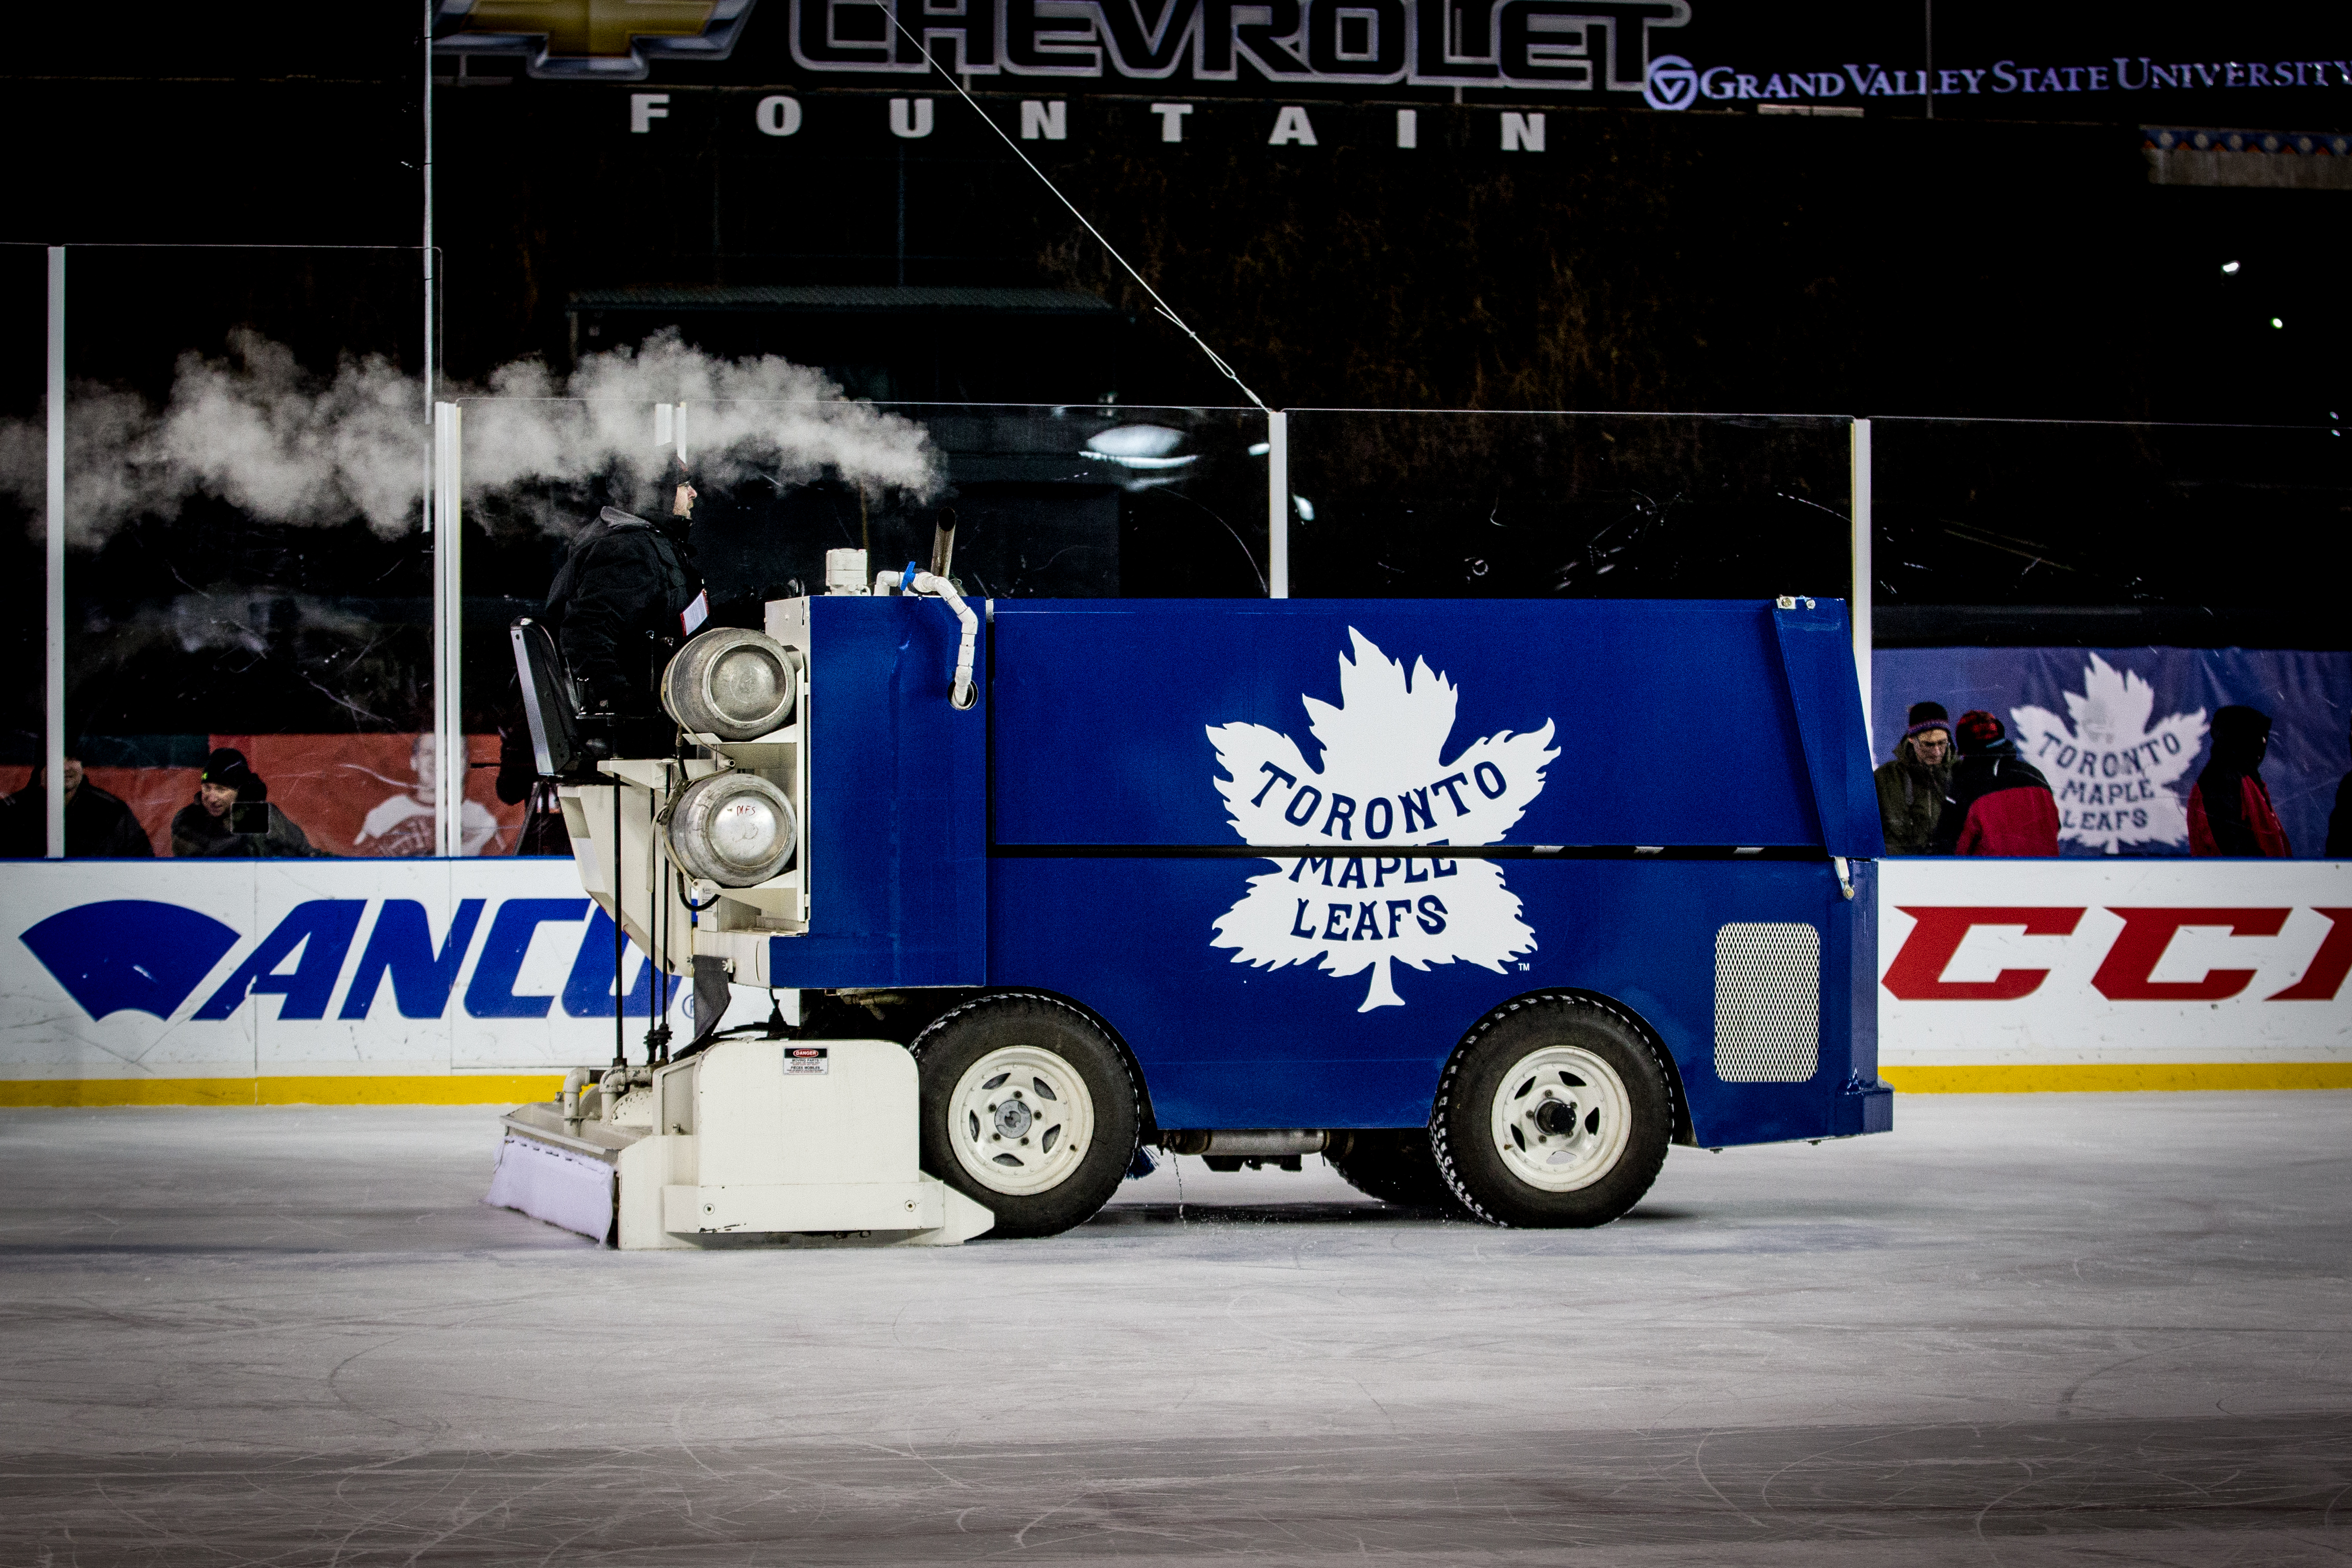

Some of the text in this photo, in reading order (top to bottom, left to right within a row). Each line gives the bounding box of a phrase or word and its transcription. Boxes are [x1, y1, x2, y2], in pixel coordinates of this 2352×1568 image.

[789, 0, 1692, 92] CHEVROLET
[1699, 57, 2352, 100] GRAND VALLEY STATE UNIVERSITY
[2038, 731, 2181, 778] TORONTO
[1250, 760, 1507, 841] TORONTO
[2060, 779, 2155, 805] MAPLE
[2062, 806, 2149, 831] LEAFS
[1288, 838, 1458, 890] MAPLE
[1290, 895, 1448, 942] LEAFS
[1518, 963, 1530, 971] TM
[1881, 906, 2352, 1001] CC
